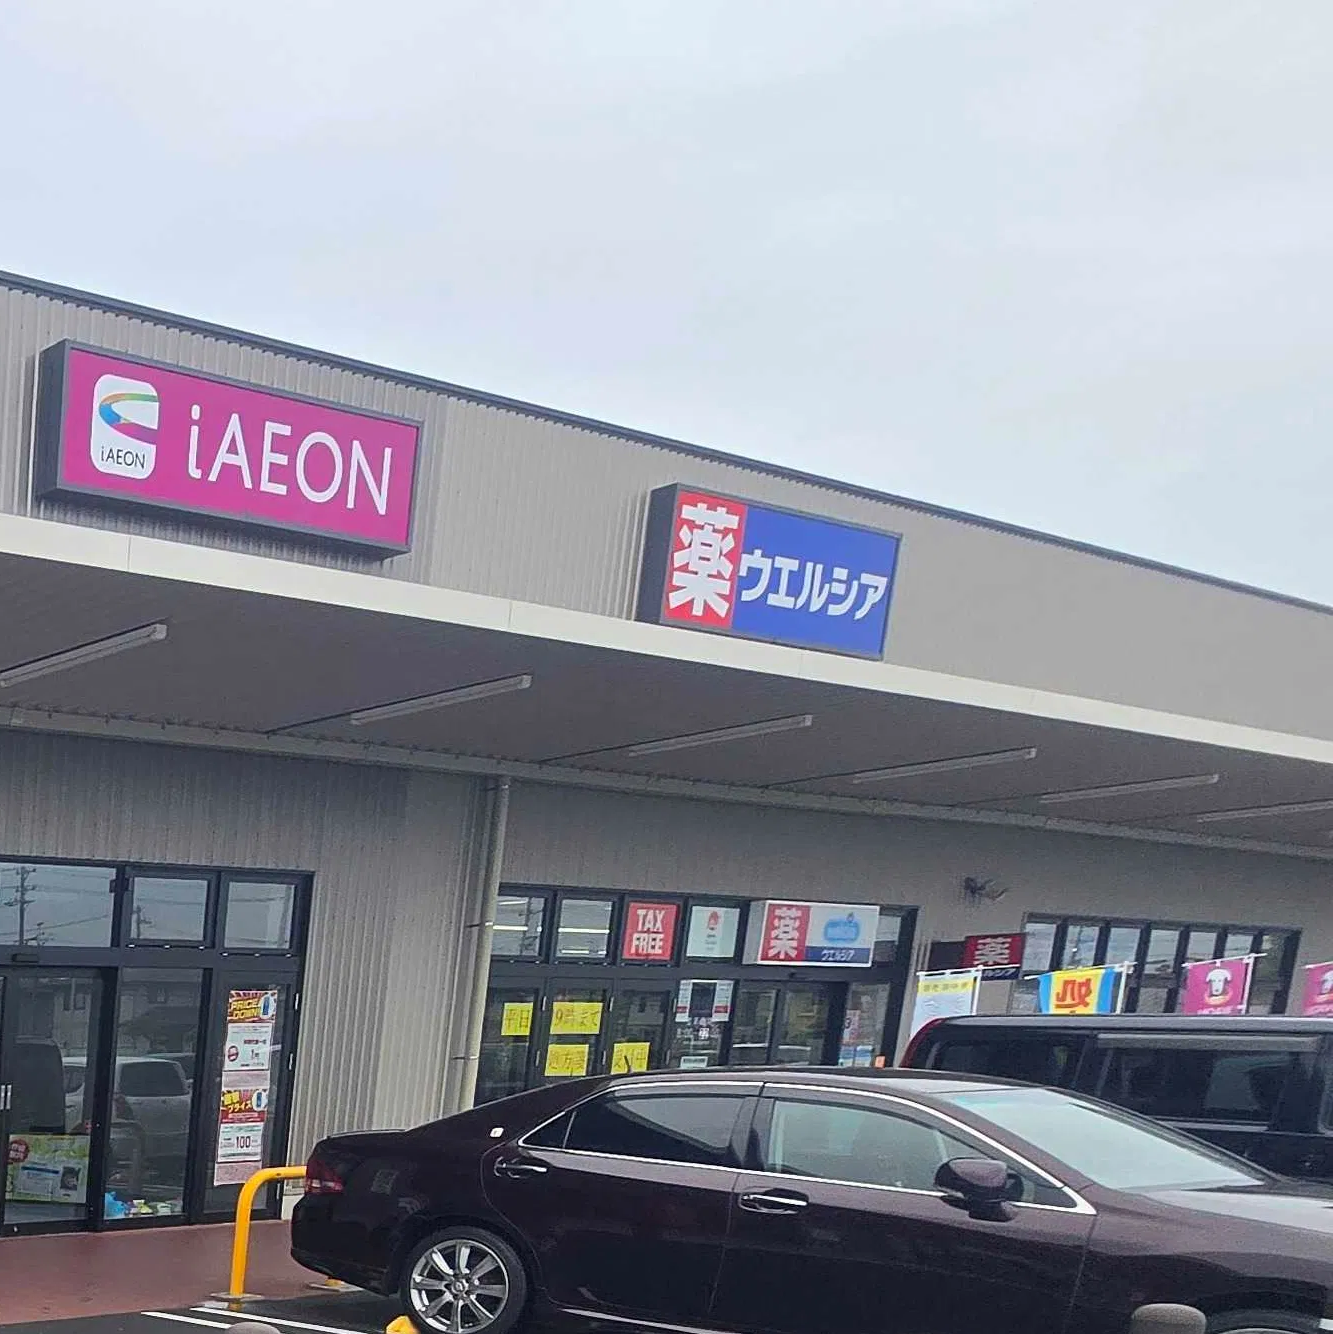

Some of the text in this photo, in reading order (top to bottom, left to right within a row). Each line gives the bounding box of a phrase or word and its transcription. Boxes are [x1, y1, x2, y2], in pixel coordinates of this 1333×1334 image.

[101, 445, 146, 470] iAEON
[188, 404, 393, 516] iAEON
[668, 502, 888, 620] 薬 ウエルシア
[636, 908, 665, 932] TAX
[768, 907, 802, 959] 薬
[631, 932, 664, 954] FREE
[973, 937, 1012, 965] 薬
[236, 1135, 251, 1149] 100
